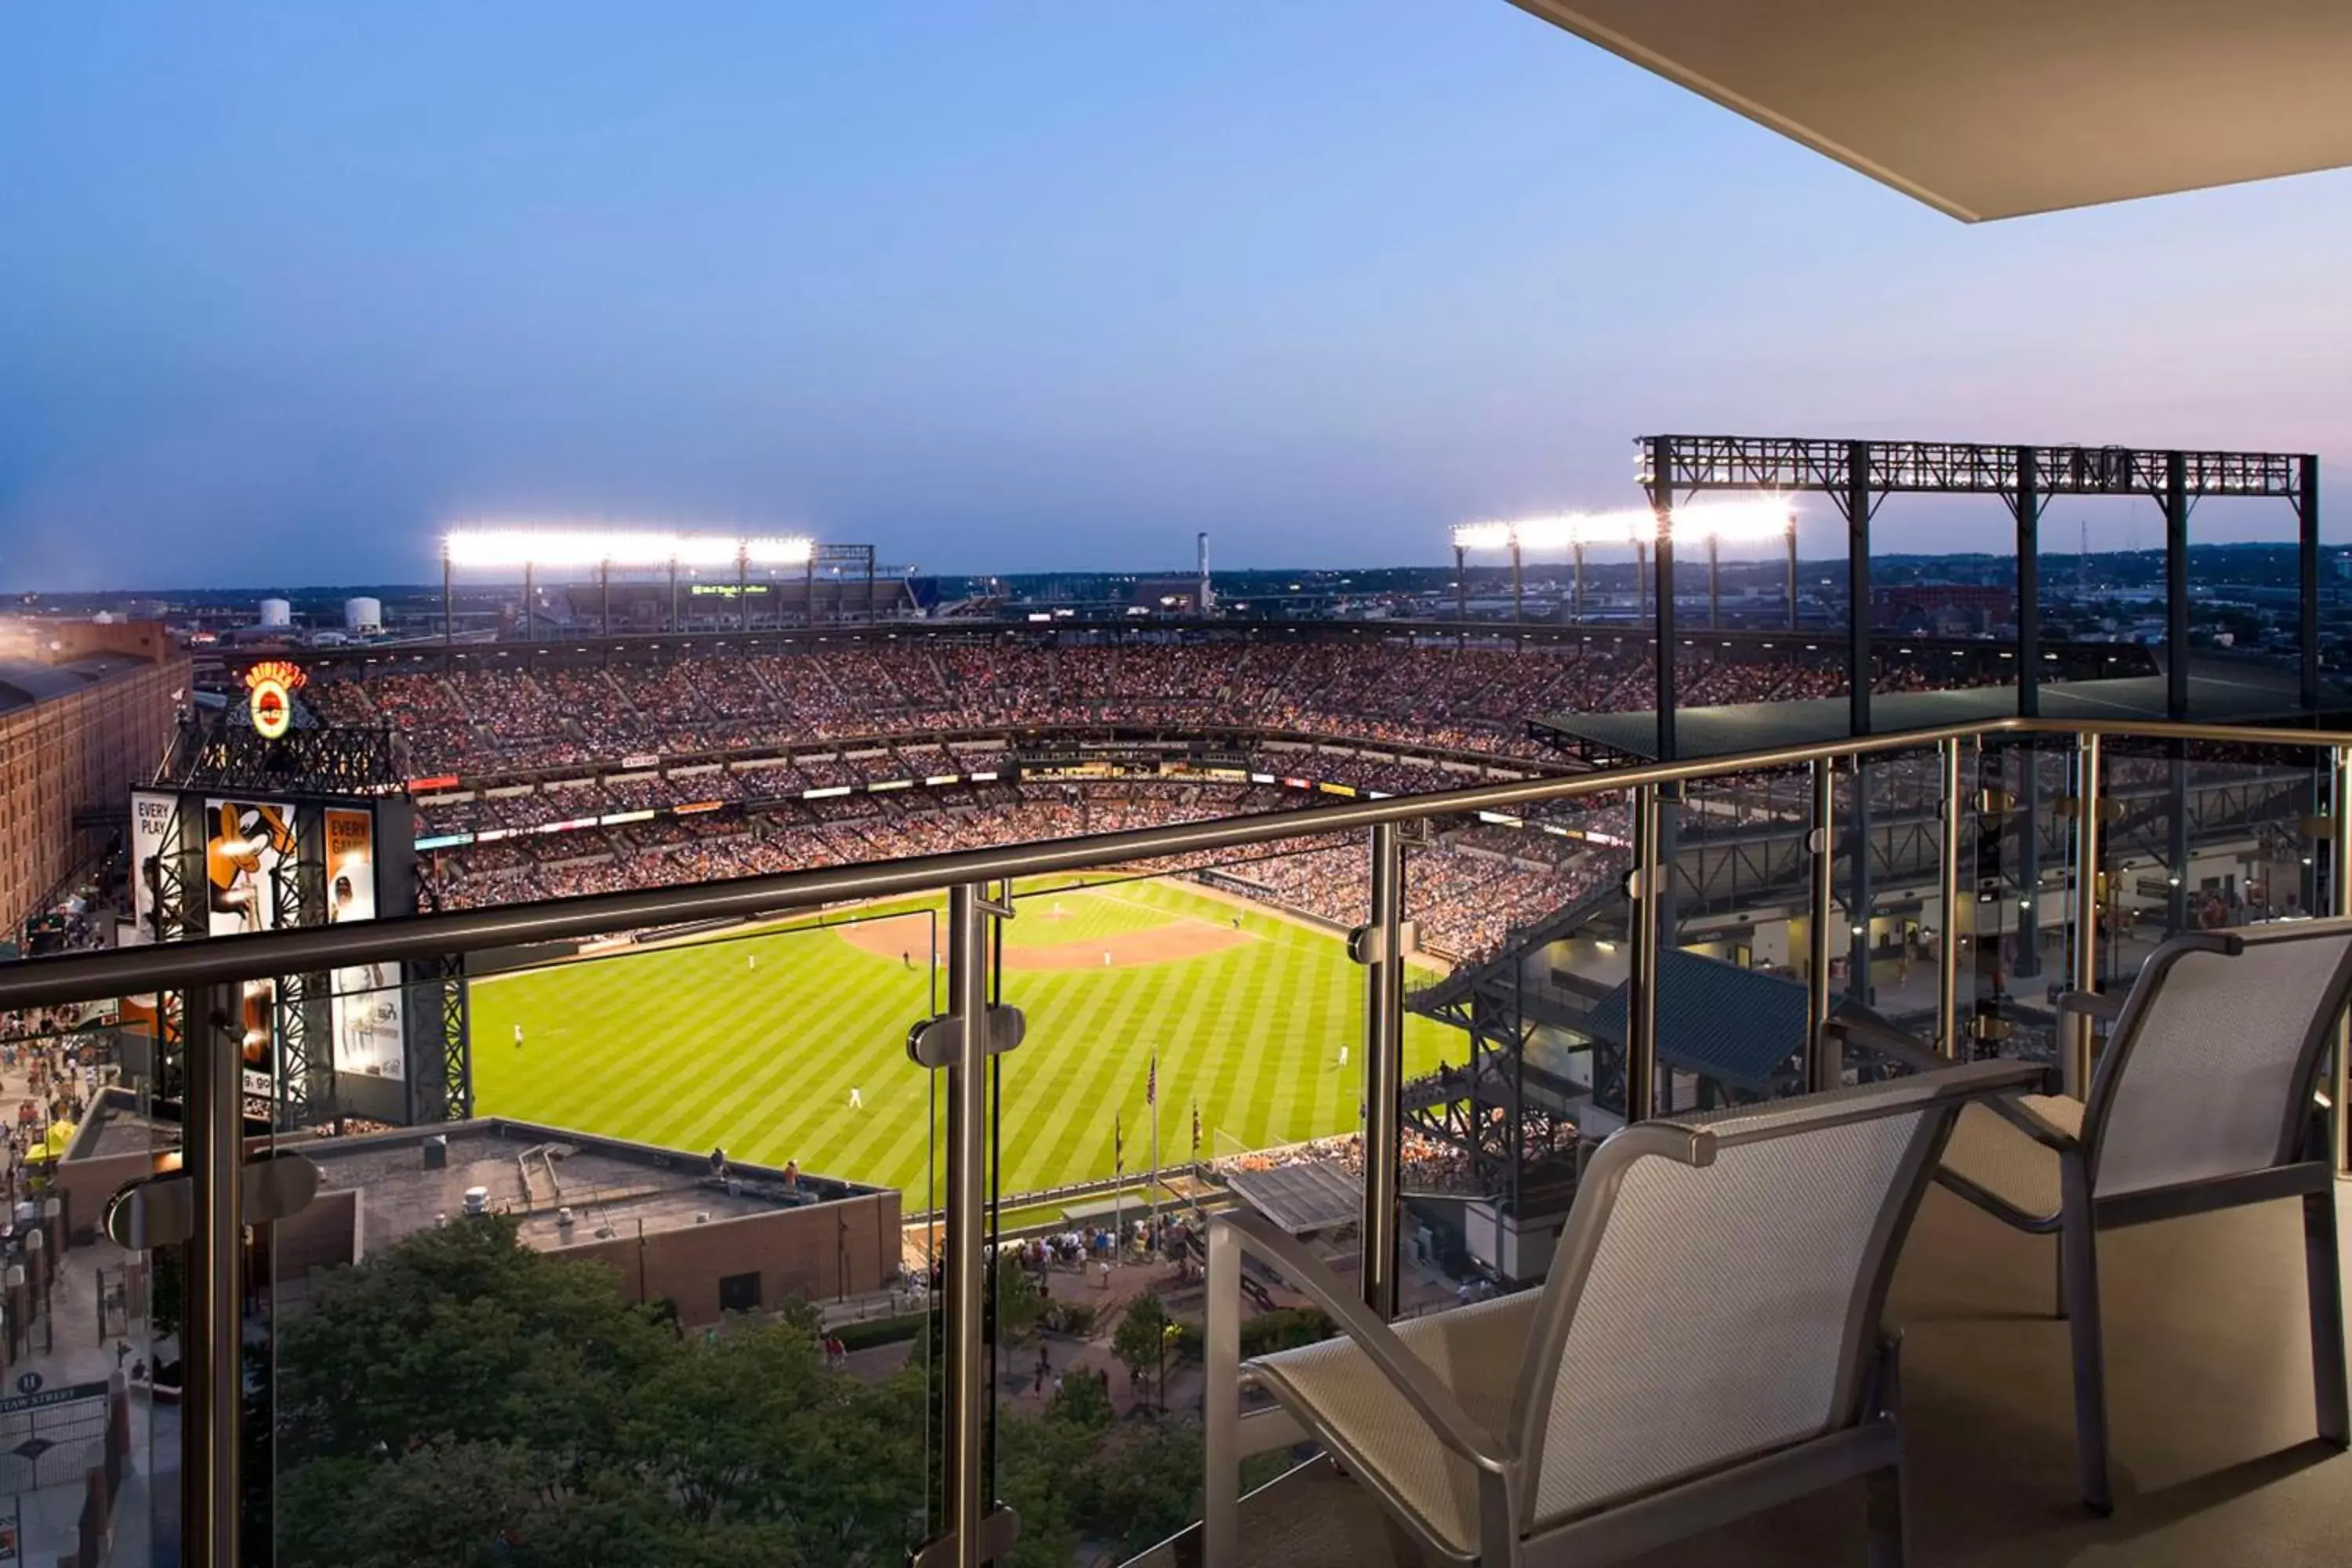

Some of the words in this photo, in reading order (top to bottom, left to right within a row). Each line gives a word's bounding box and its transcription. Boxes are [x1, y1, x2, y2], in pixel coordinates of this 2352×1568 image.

[139, 802, 169, 818] EVERY
[142, 819, 165, 835] PLAY
[332, 820, 366, 837] EVERY
[31, 1388, 74, 1405] STREET
